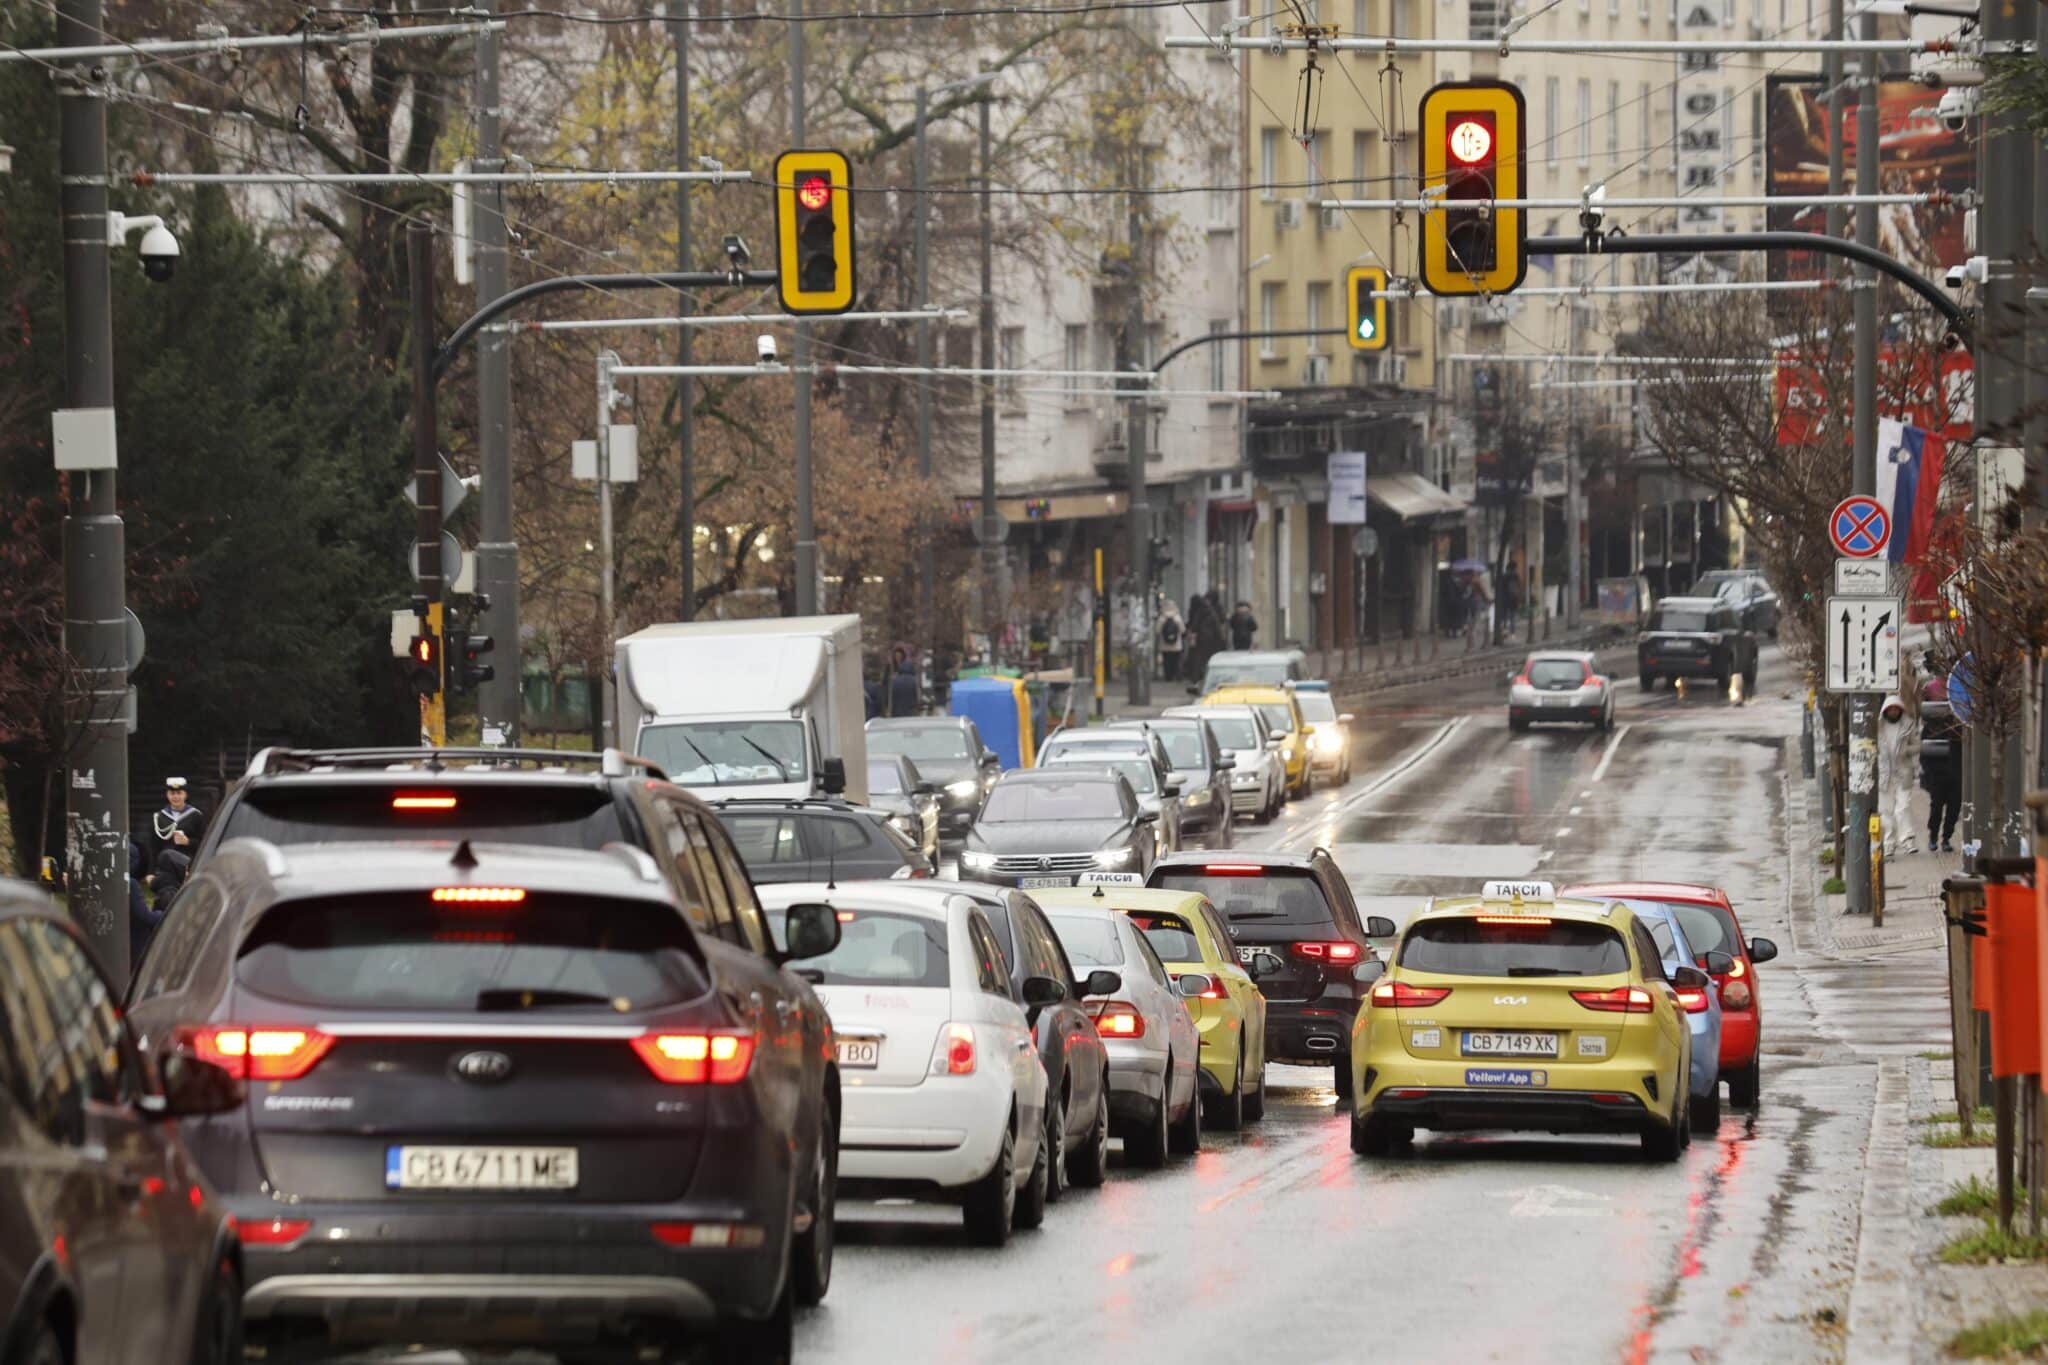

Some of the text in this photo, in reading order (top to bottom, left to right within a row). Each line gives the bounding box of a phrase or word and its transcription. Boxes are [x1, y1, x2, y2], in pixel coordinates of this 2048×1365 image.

[1089, 873, 1133, 883] ТАКСИ
[1496, 885, 1541, 896] ТАКСИ
[1472, 1032, 1554, 1052] CB 7149 XK
[1468, 1071, 1529, 1085] Yellow! App
[408, 1154, 571, 1181] CB 6711 ME
